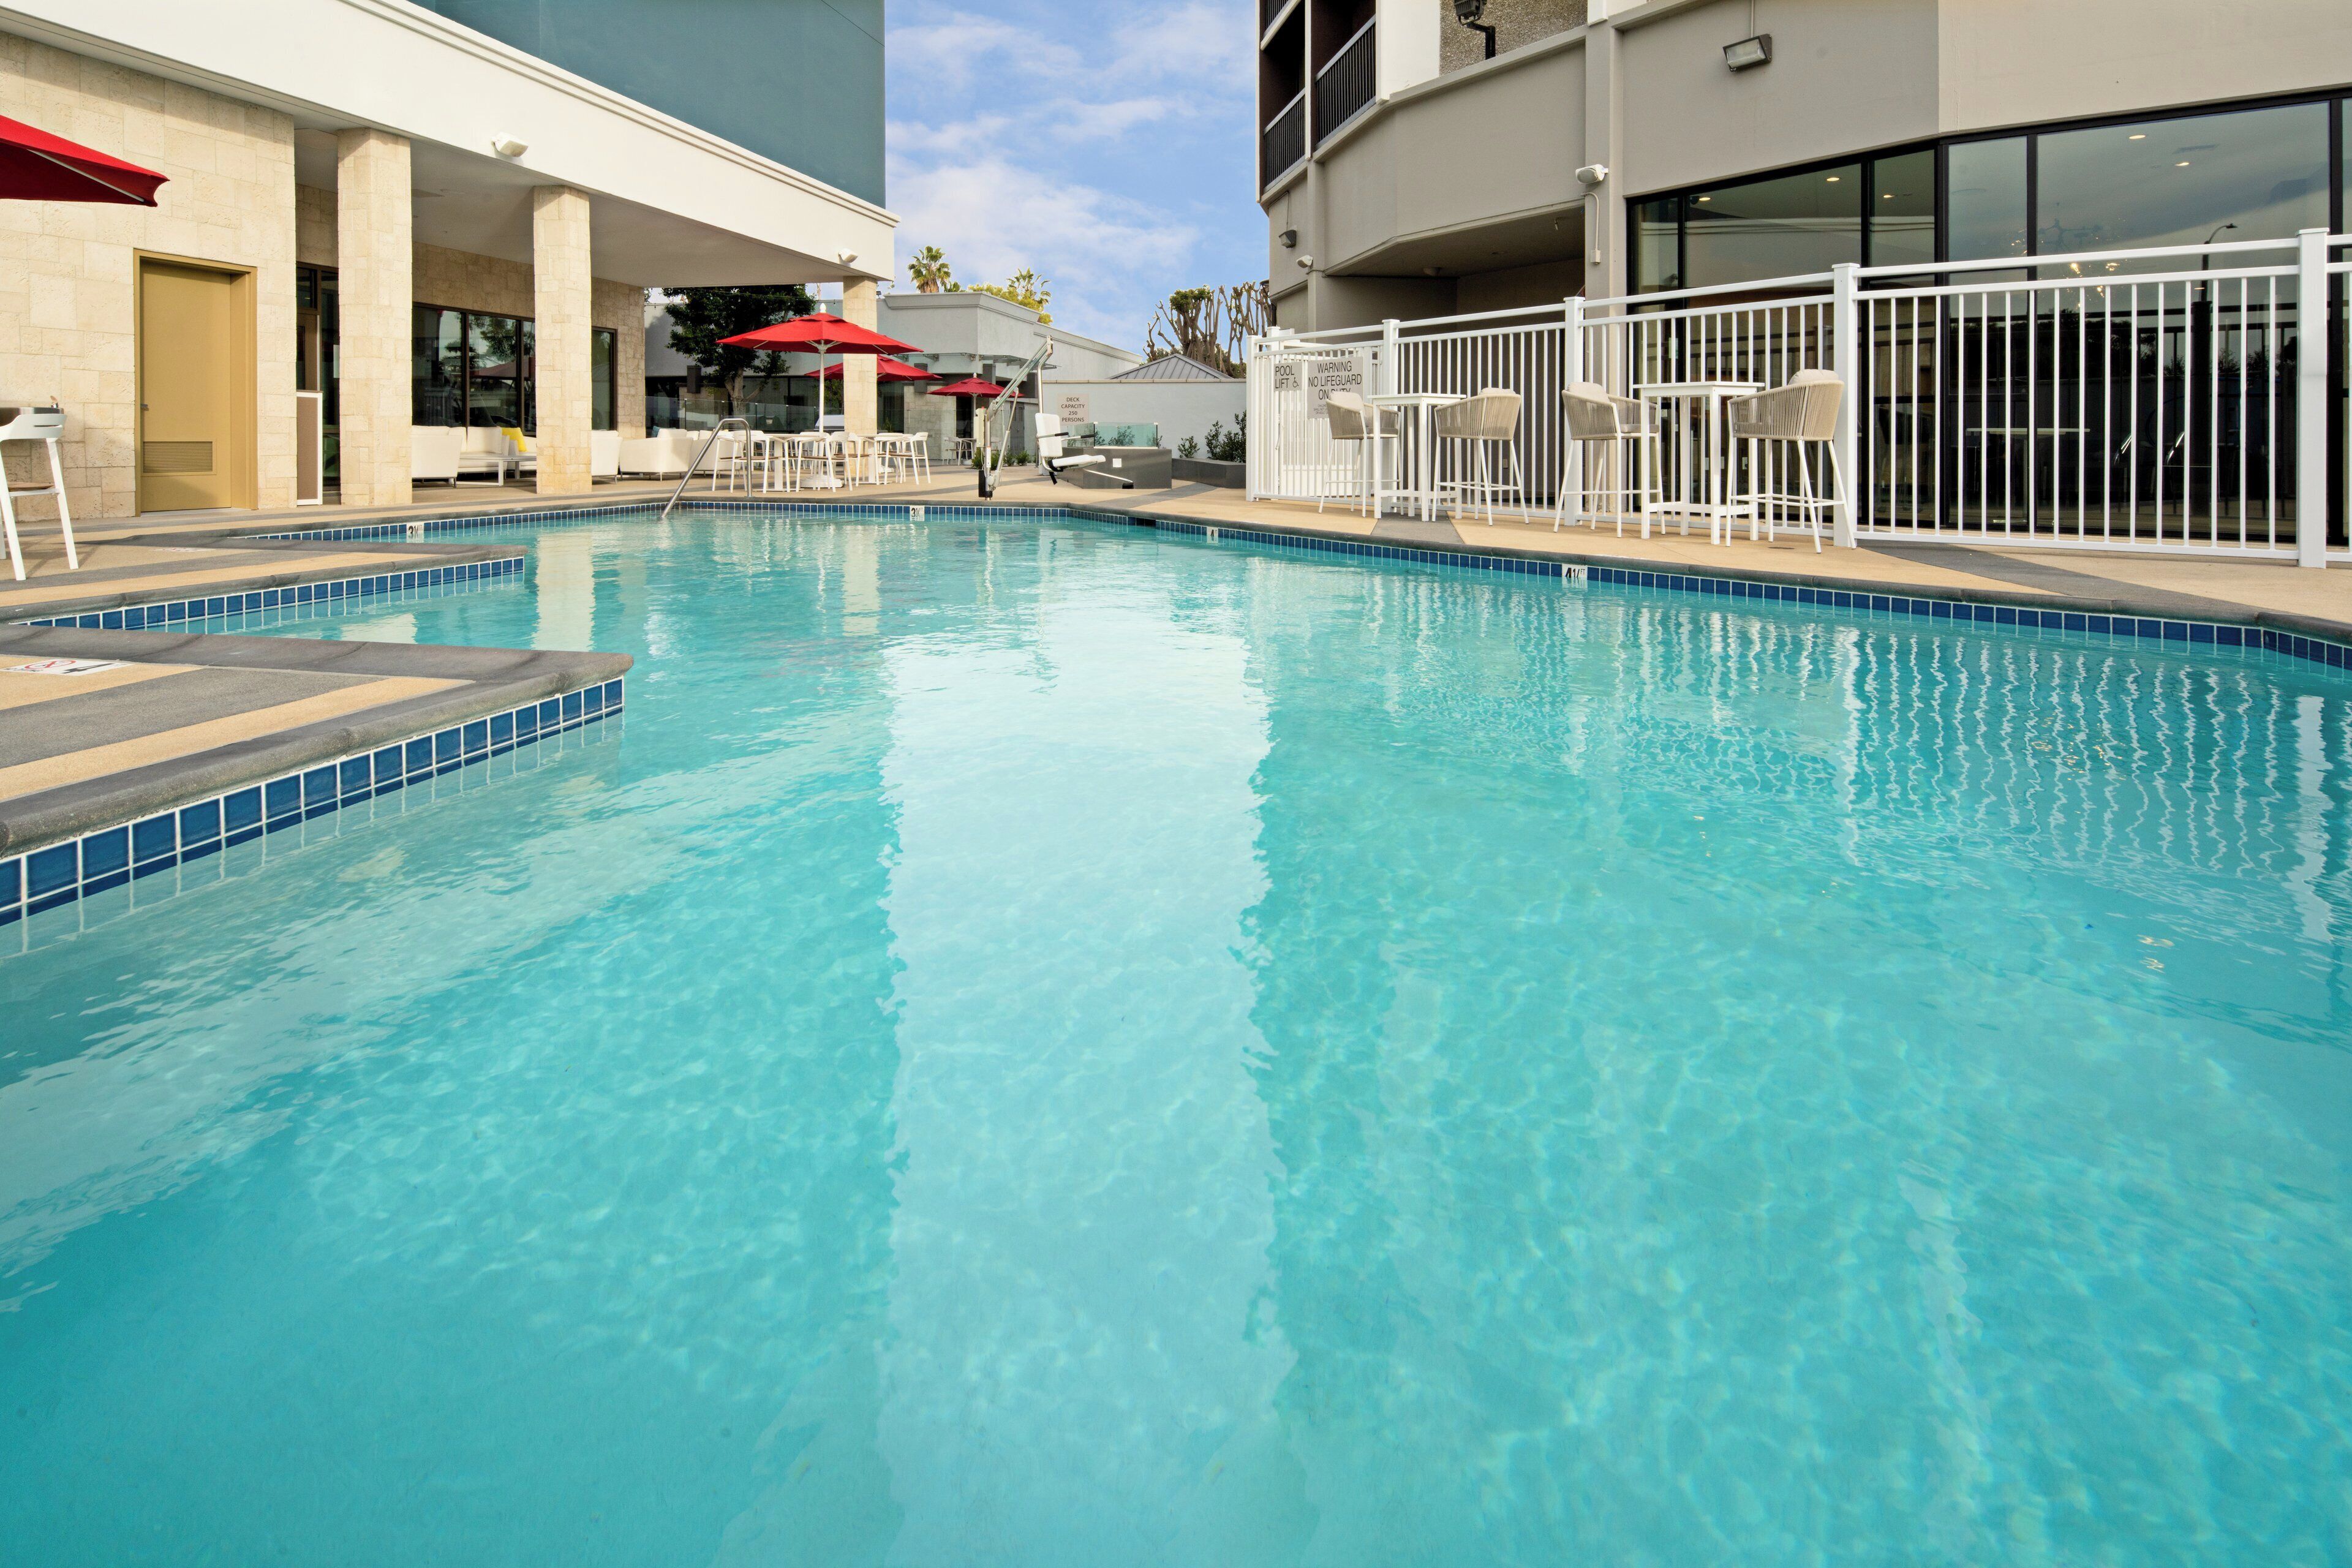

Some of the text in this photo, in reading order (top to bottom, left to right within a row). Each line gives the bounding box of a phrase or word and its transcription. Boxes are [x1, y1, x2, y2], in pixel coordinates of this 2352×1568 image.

[1275, 365, 1295, 376] POOL
[1317, 361, 1352, 374] WARNING
[1275, 378, 1289, 389] LIFT
[1308, 374, 1362, 387] NO LIFEGUARD
[1318, 389, 1329, 400] ON
